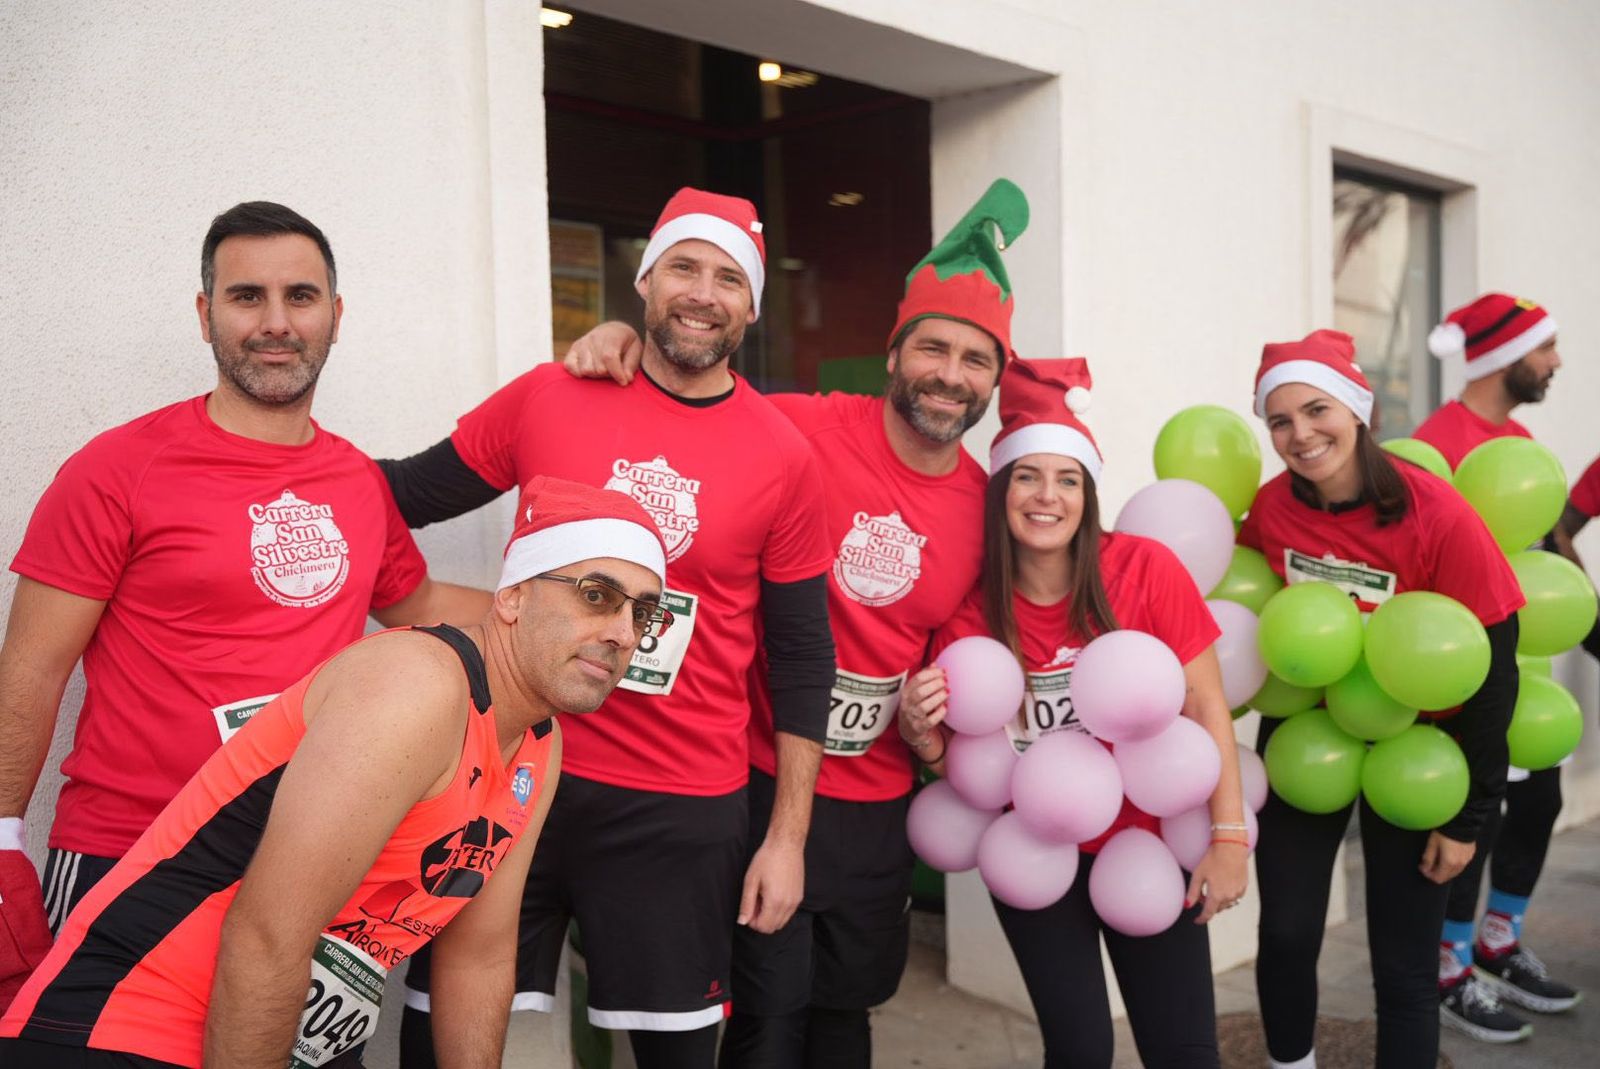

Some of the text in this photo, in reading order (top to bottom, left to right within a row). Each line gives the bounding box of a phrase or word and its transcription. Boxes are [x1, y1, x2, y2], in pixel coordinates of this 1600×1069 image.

[612, 458, 701, 494] Carrera
[632, 484, 675, 510] San
[248, 504, 333, 525] Carrera
[276, 523, 323, 545] San
[853, 511, 928, 548] Carrera
[253, 540, 349, 568] Silvestre
[867, 535, 904, 561] San
[274, 562, 335, 578] Chiclanera
[840, 545, 921, 580] Silvestre
[324, 943, 353, 970] CARRERA
[349, 963, 362, 977] SAN
